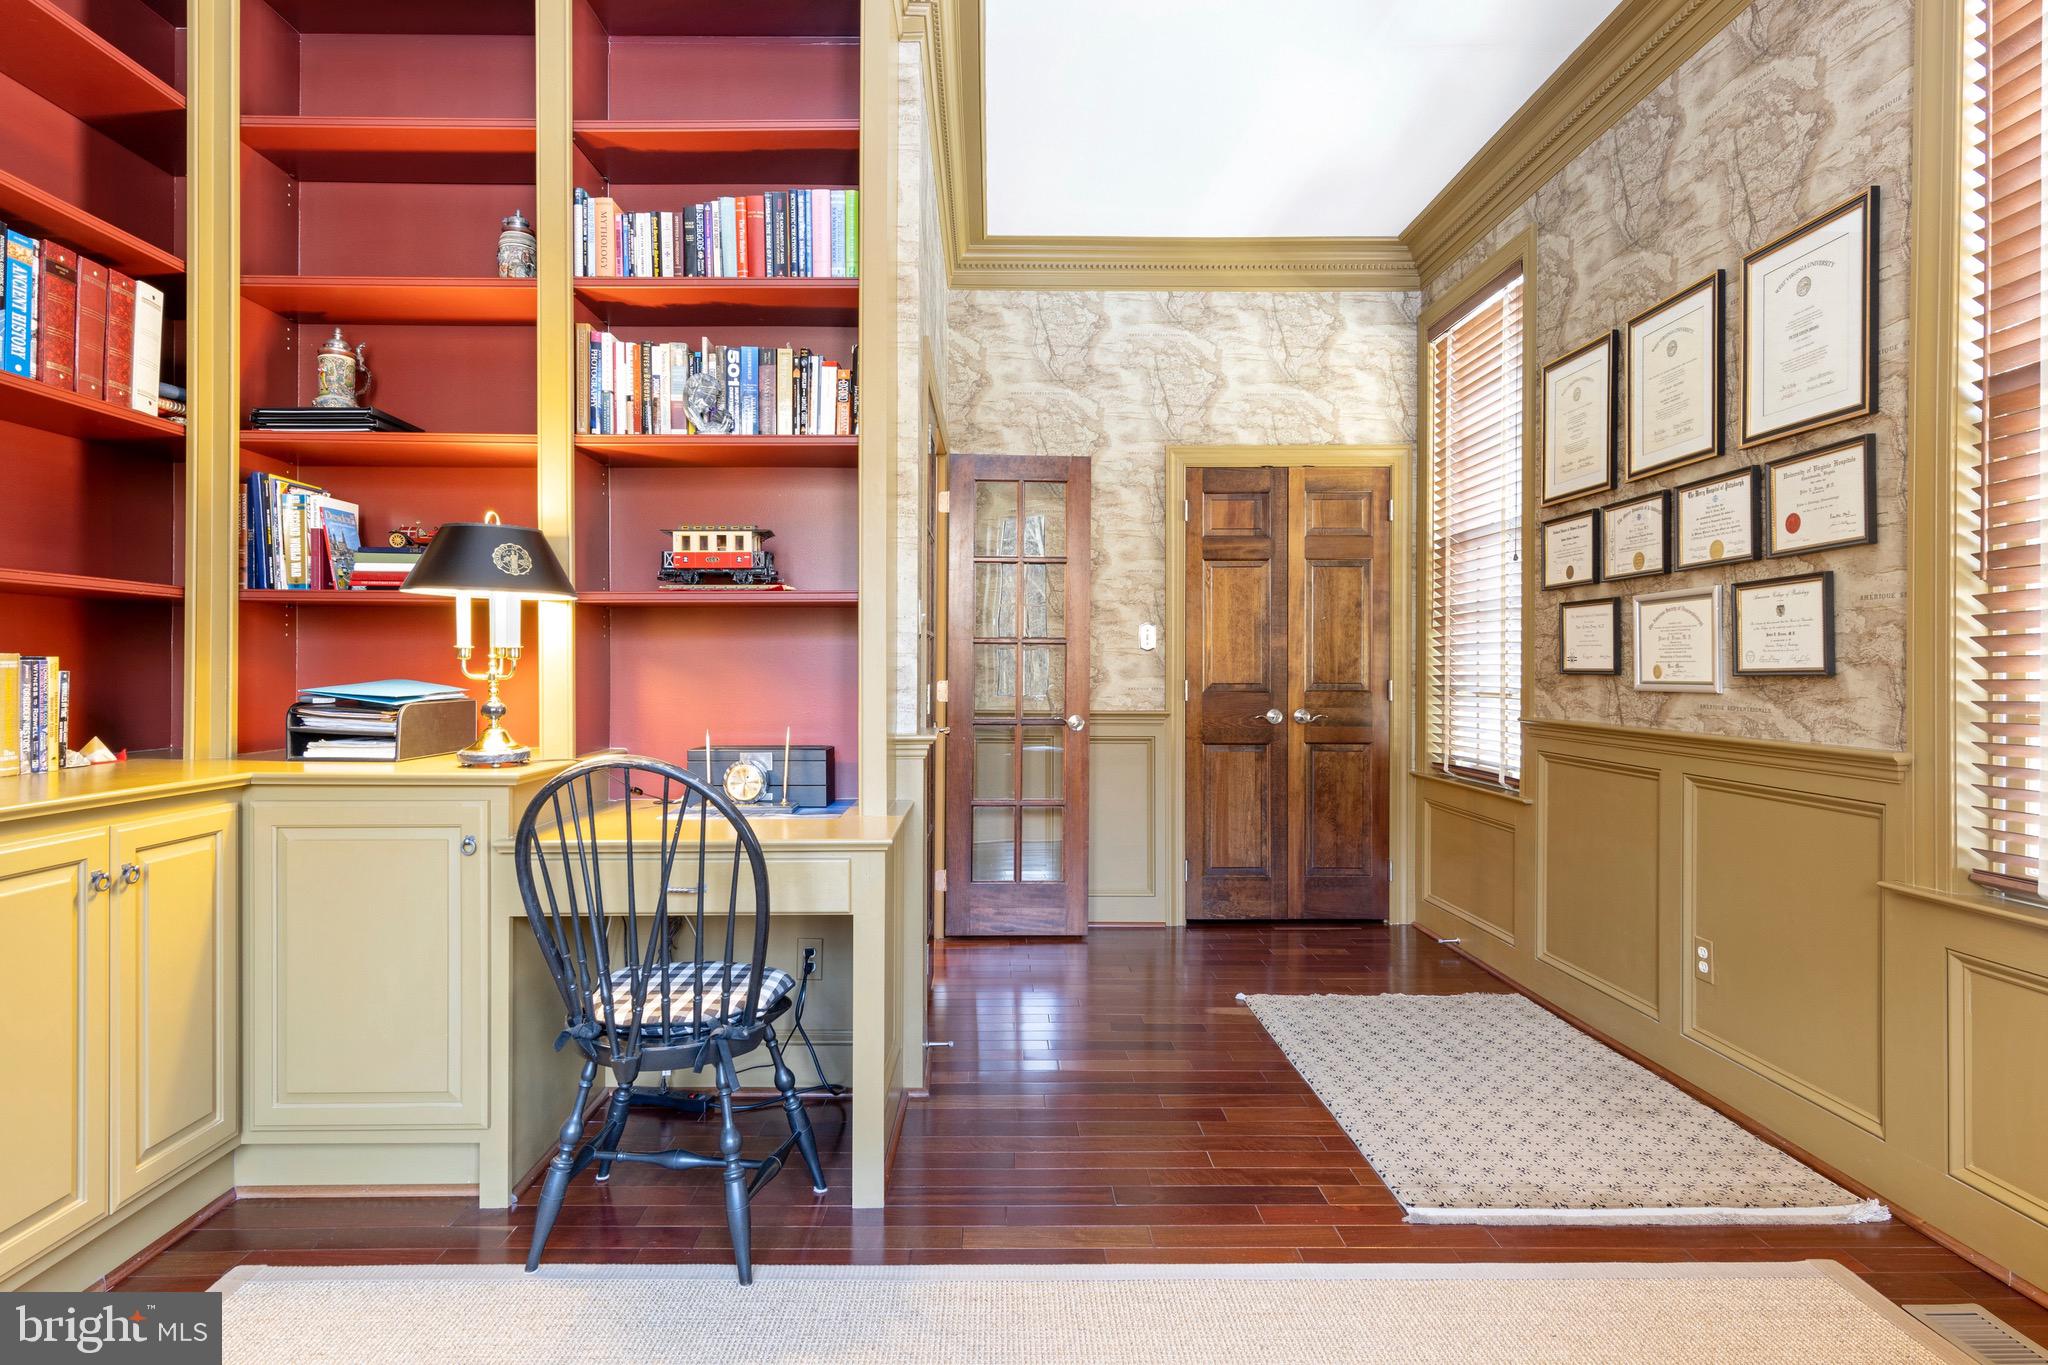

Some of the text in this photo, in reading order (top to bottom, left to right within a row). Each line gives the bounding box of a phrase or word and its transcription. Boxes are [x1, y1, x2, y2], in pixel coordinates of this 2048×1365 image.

[600, 211, 608, 270] MYTHOLOGY
[696, 212, 704, 250] SUPERGODS
[1785, 264, 1808, 282] VIRGINIA
[1807, 260, 1836, 269] UNIVERSITY
[11, 262, 28, 360] ANCIENT HISTORY
[643, 343, 651, 367] THIEVES
[727, 349, 740, 386] 501
[590, 349, 599, 408] PHOTOGRAPHY
[643, 374, 651, 401] BAGHDAD
[290, 537, 301, 561] WORLD
[291, 562, 302, 578] WAR
[22, 683, 30, 752] FORBIDDEN HISTORY
